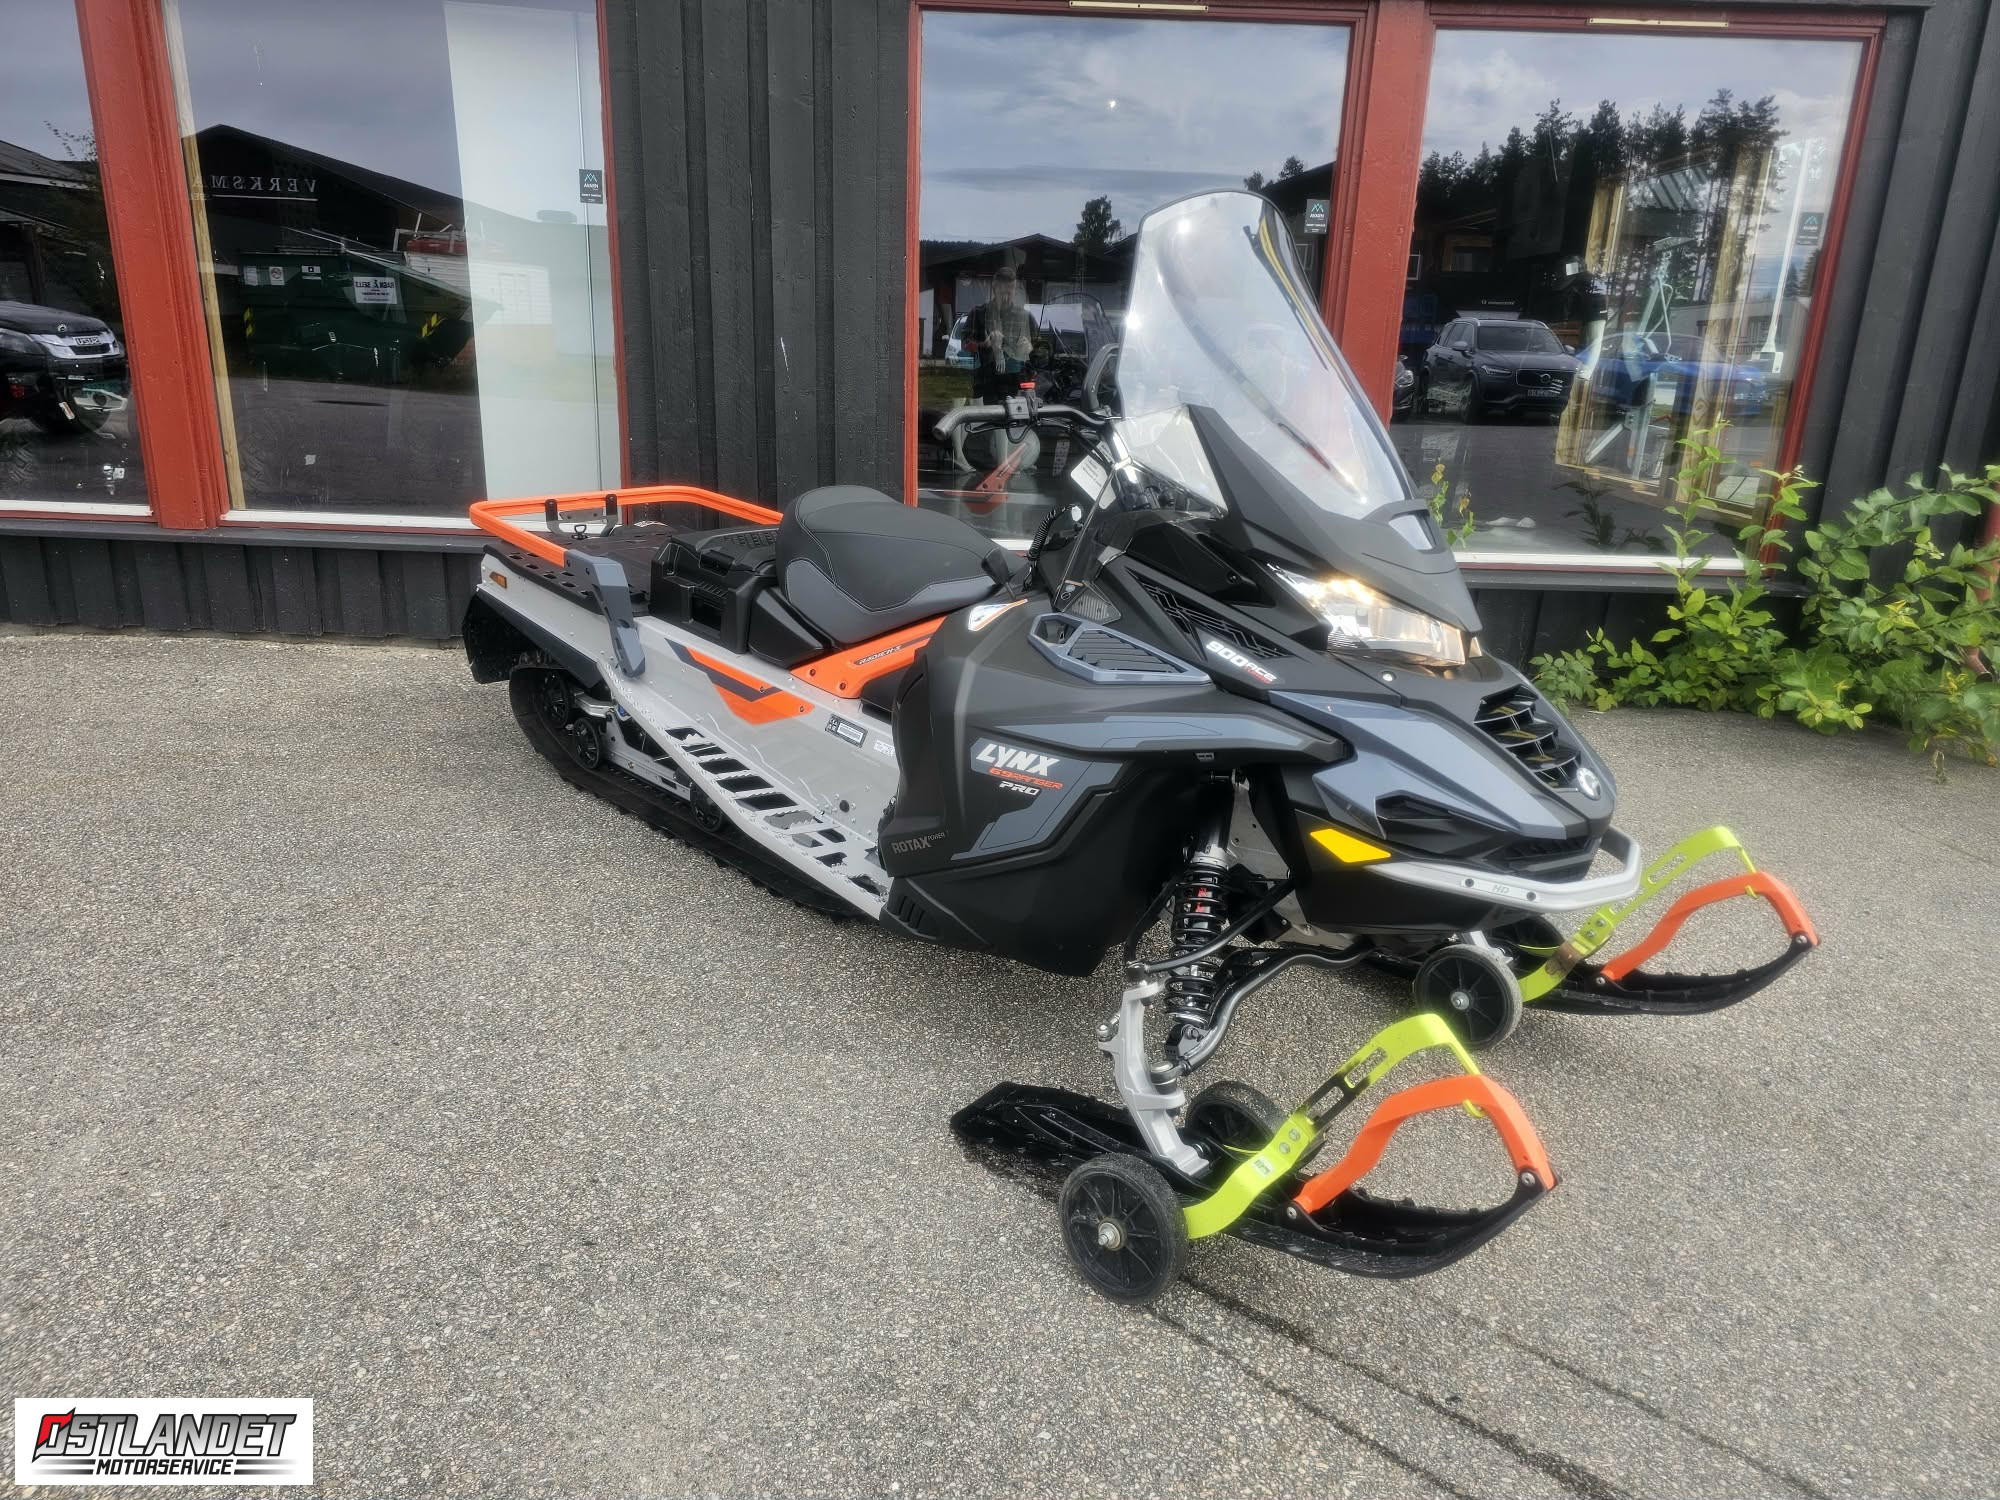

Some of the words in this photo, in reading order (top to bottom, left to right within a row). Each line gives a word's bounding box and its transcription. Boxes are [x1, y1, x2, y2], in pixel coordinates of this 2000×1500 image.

[1205, 640, 1249, 668] 900
[1245, 662, 1278, 682] ACE
[975, 743, 1061, 777] LYNX
[999, 780, 1041, 796] PRO
[890, 836, 931, 854] ROTAX
